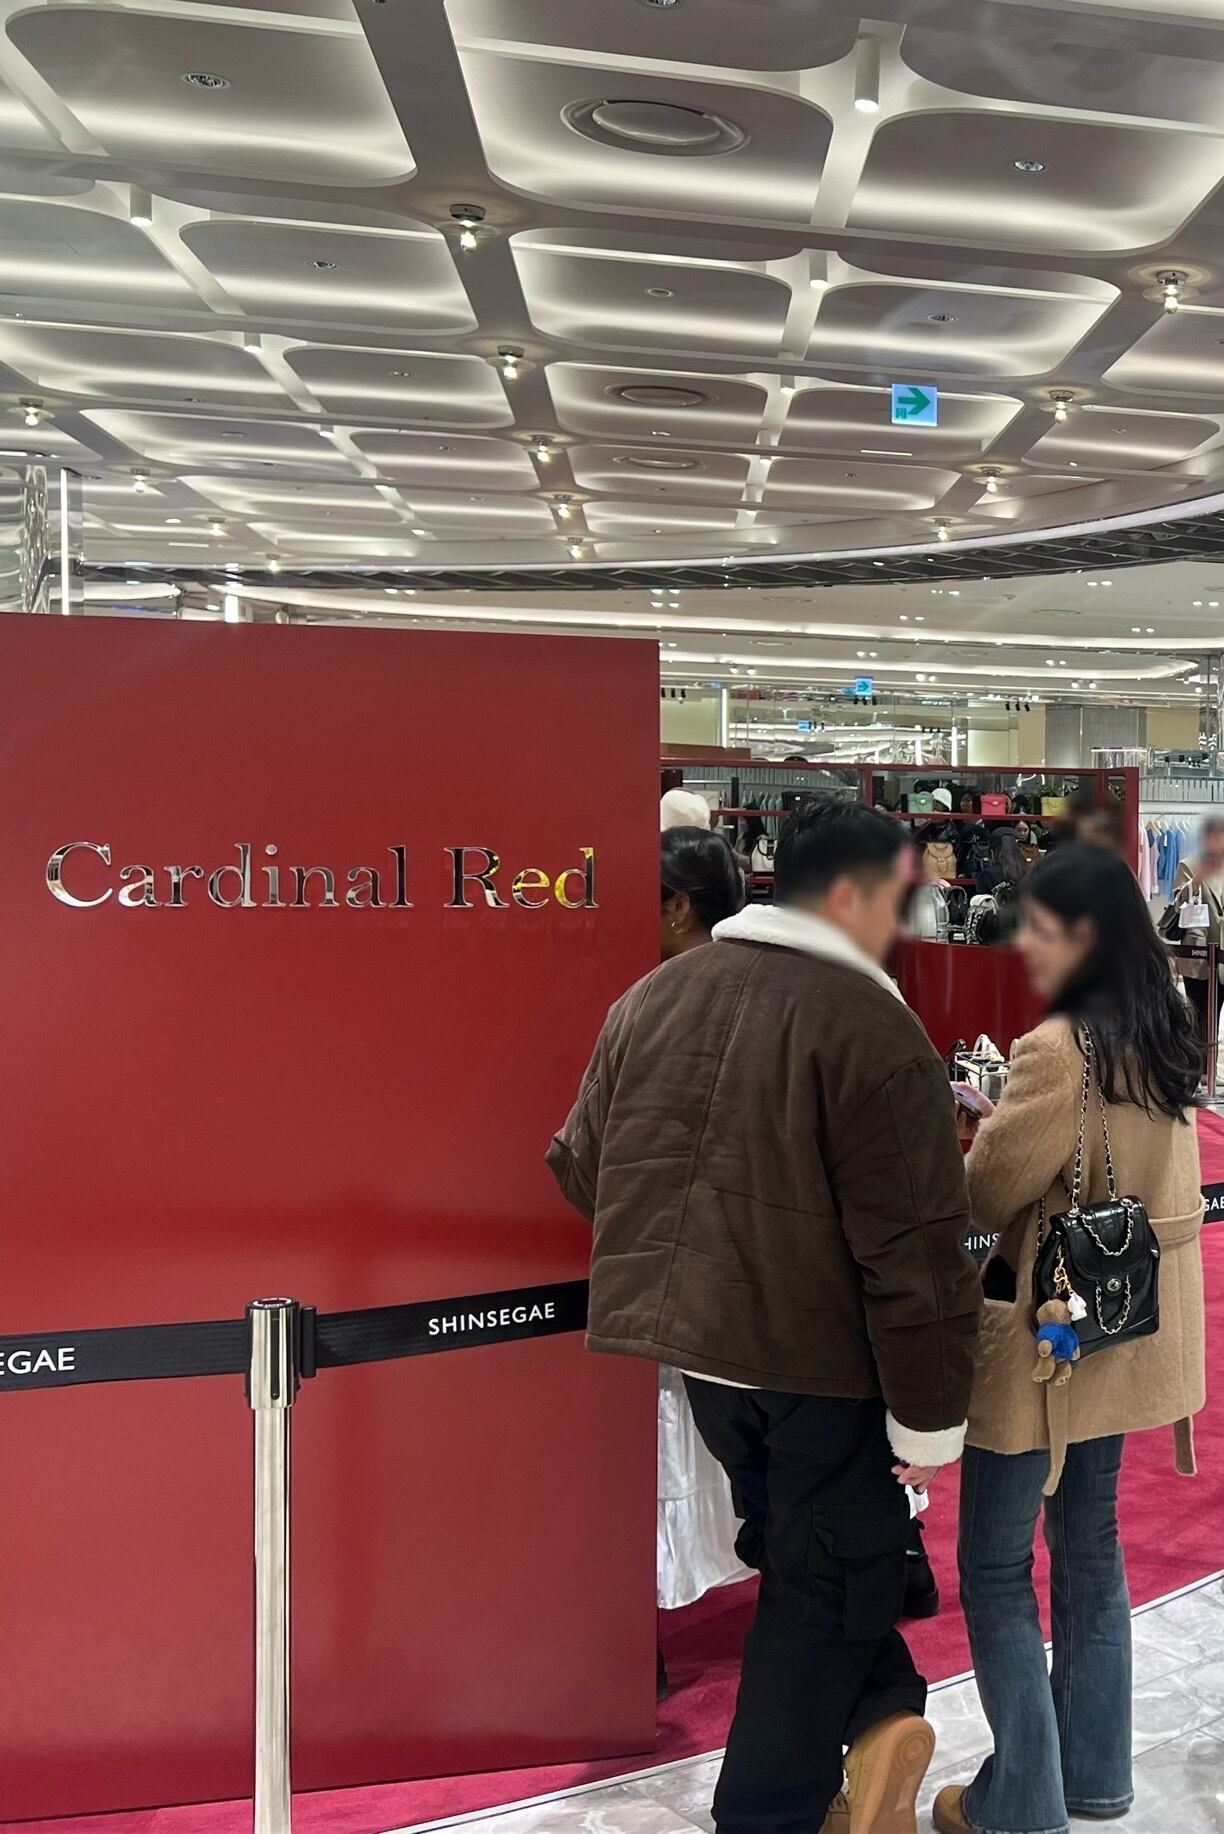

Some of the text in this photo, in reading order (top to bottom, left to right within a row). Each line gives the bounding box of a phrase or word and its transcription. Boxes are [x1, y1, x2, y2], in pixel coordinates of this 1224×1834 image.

[45, 841, 600, 909] Cardinal Red
[428, 1302, 555, 1336] SHINSEGAE
